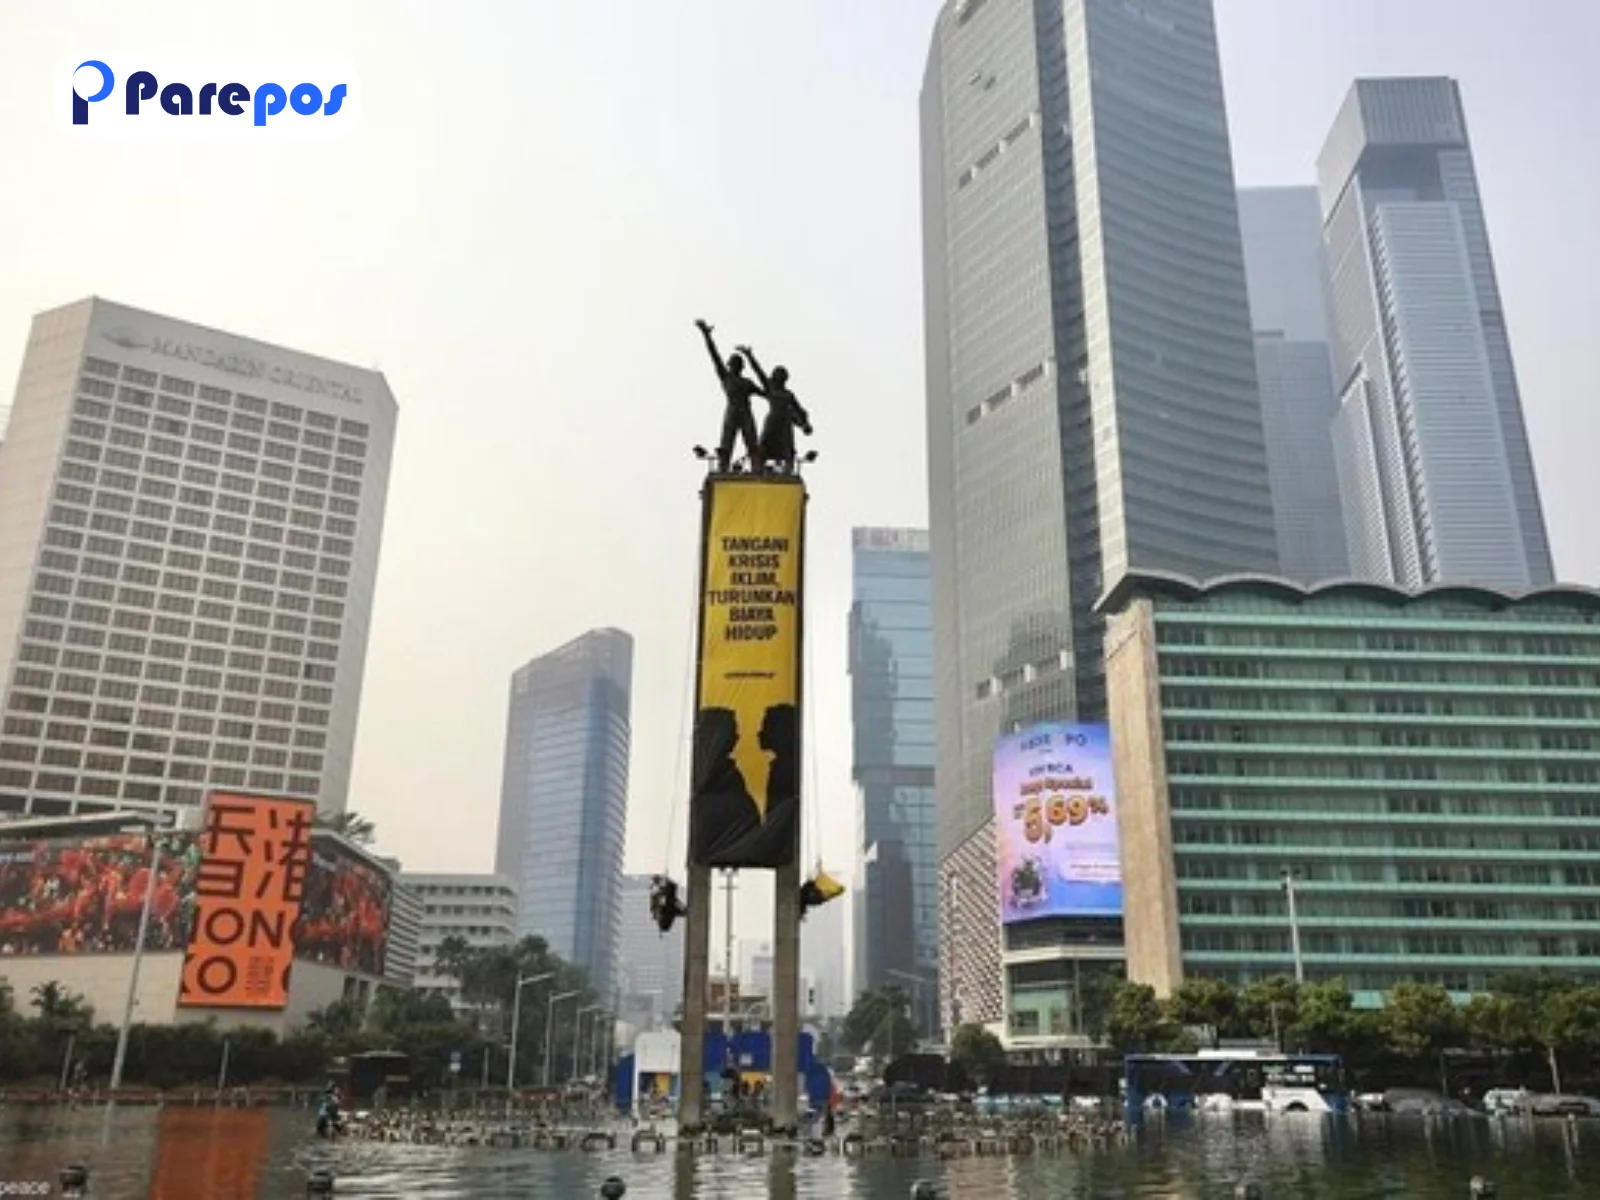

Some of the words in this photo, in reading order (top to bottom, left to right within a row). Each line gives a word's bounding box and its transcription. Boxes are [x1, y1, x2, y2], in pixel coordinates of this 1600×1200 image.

[722, 537, 789, 552] TANGANI
[728, 554, 780, 569] KRISIS
[708, 590, 795, 606] TURUNKAN
[730, 607, 773, 622] BIAYA
[725, 625, 778, 640] HIDUP
